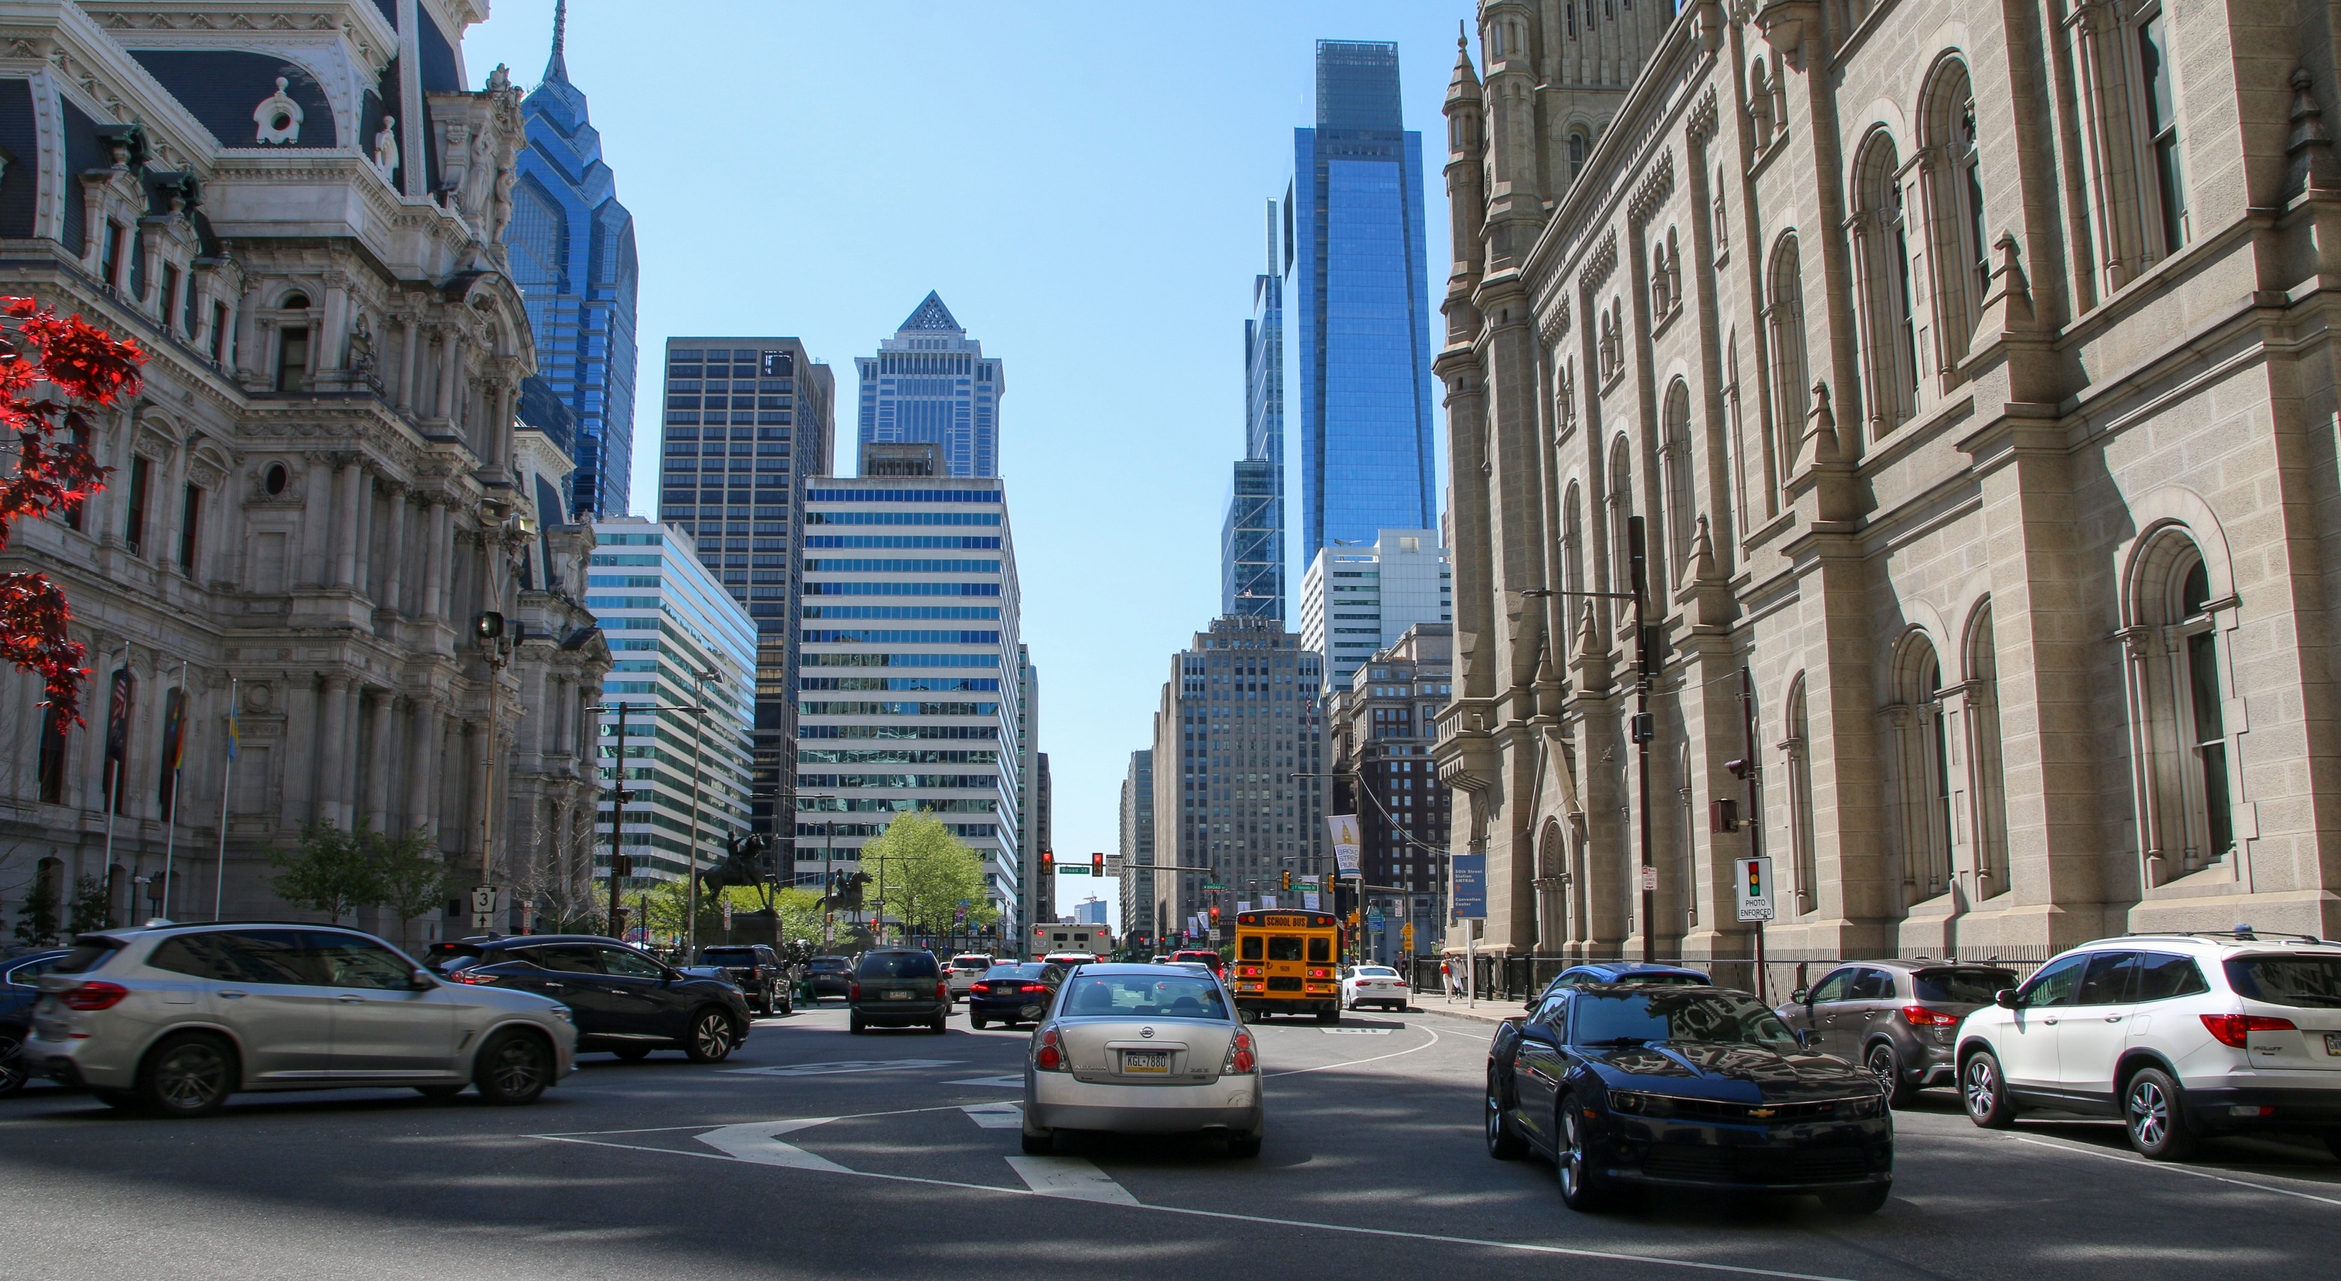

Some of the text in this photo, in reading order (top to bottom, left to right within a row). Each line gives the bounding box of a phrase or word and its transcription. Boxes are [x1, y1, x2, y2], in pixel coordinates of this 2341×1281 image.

[479, 892, 488, 906] 3
[1745, 898, 1766, 907] PHOTO
[1740, 908, 1772, 917] ENFORCED
[1266, 916, 1306, 927] SCHOOL BUS
